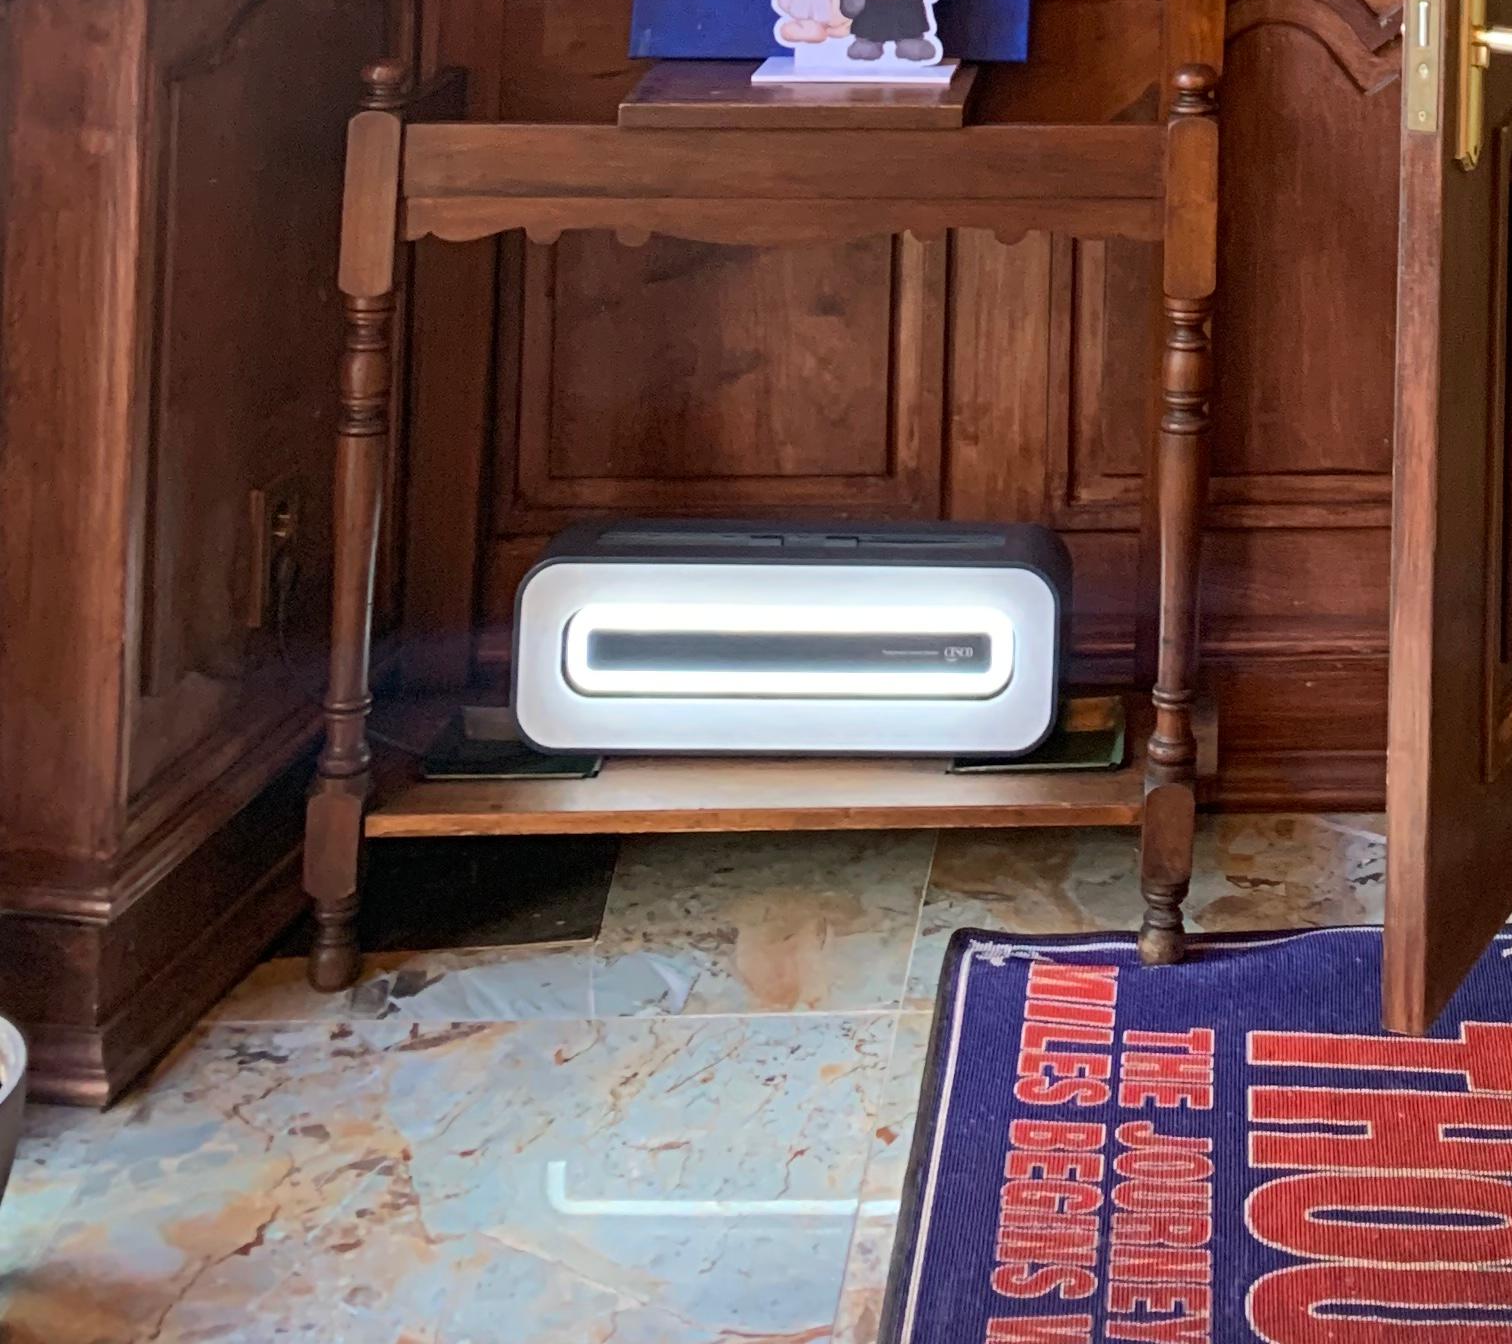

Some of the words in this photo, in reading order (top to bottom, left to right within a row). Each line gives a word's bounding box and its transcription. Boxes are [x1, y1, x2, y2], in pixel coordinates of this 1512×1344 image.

[1118, 1027, 1214, 1110] THE
[990, 1118, 1107, 1300] BEGINS
[1105, 1120, 1214, 1344] JOURNEY
